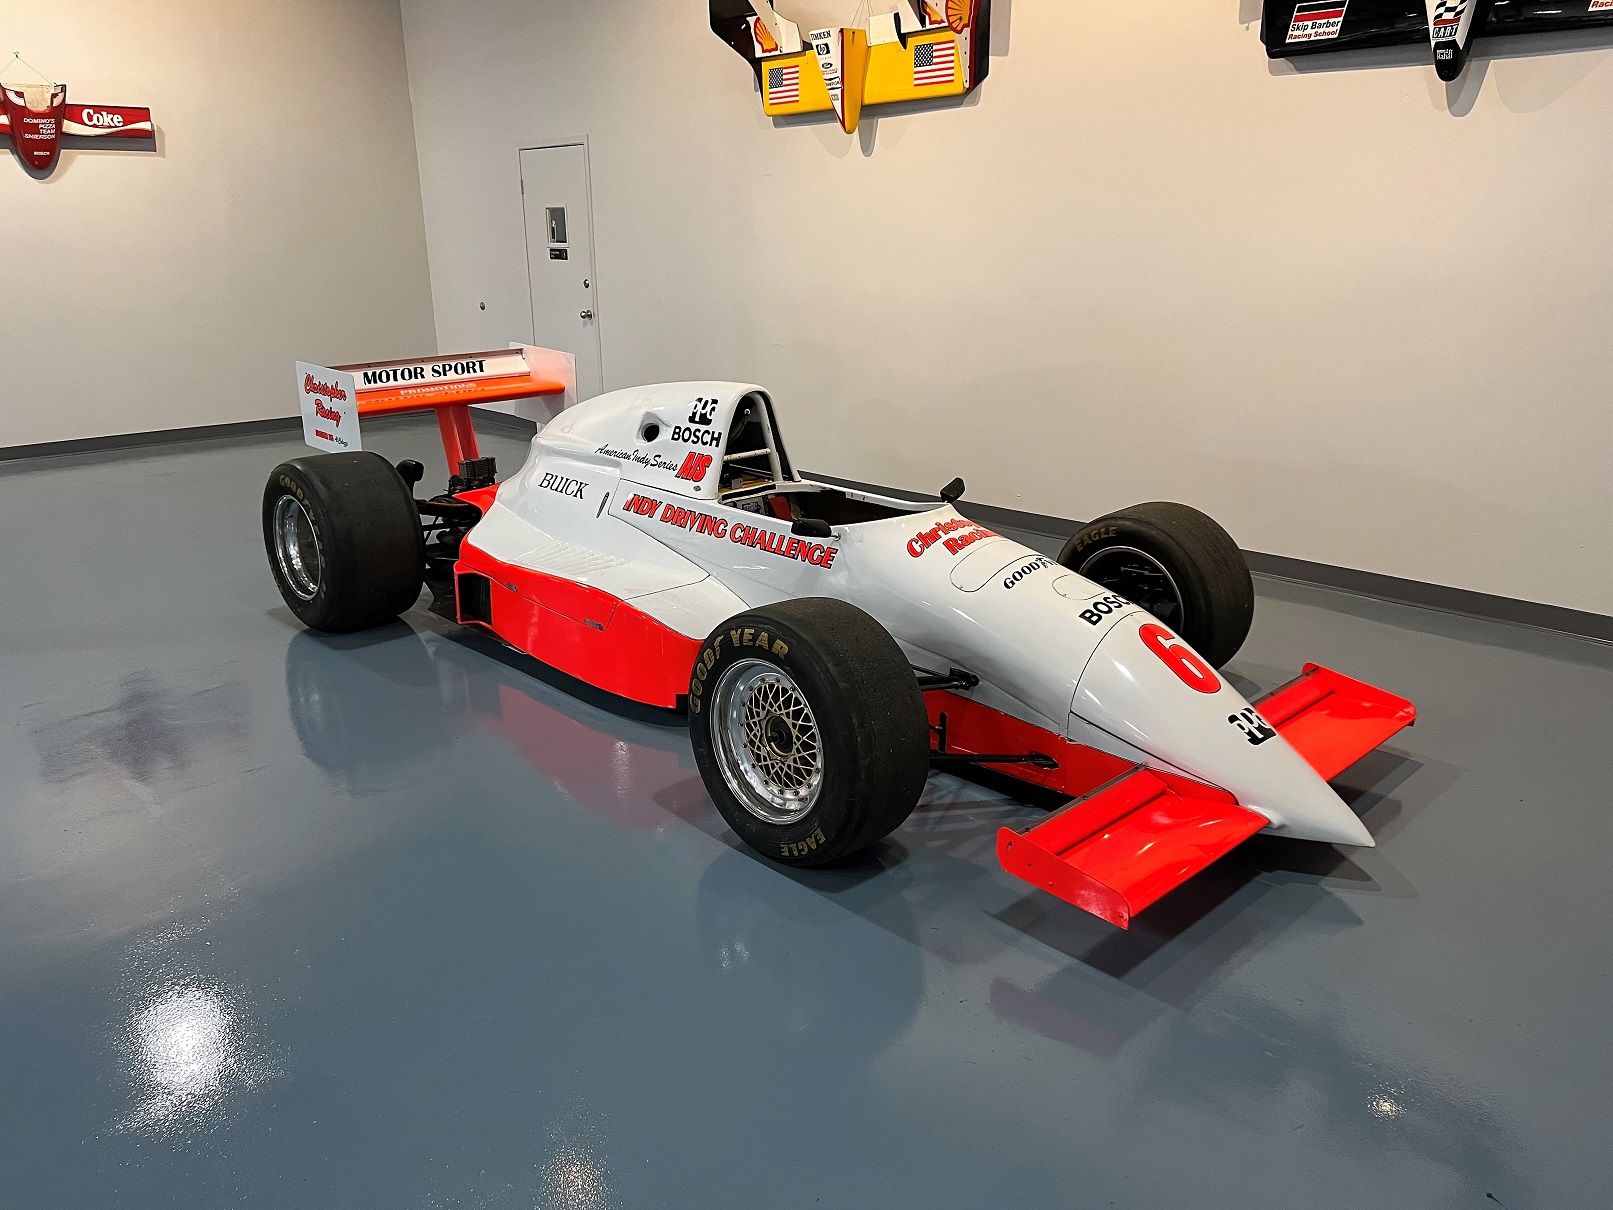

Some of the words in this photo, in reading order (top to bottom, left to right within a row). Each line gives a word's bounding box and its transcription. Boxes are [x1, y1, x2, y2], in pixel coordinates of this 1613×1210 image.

[1591, 0, 1613, 8] Raci
[1288, 33, 1312, 41] Racing
[1313, 29, 1339, 38] School
[1290, 23, 1309, 32] Skip
[1310, 20, 1341, 30] Barber
[81, 108, 124, 127] Coke
[362, 366, 426, 385] MOTOR
[431, 359, 486, 378] SPORT
[304, 373, 347, 402] Christopher
[399, 383, 477, 395] PROMOTIONS
[315, 398, 342, 428] Racing
[671, 425, 723, 448] BOSCH
[594, 443, 632, 462] American
[631, 448, 653, 469] Indy
[650, 454, 678, 472] Series
[674, 451, 713, 483] AIS
[538, 472, 589, 500] BUICK
[622, 493, 663, 519] INDY
[659, 503, 728, 539] DRIVING
[729, 523, 839, 570] CHALLENGE
[1074, 526, 1118, 552] EAGLE
[1078, 594, 1133, 626] BOSC
[1138, 623, 1222, 694] 6
[780, 827, 826, 857] EAGLE
